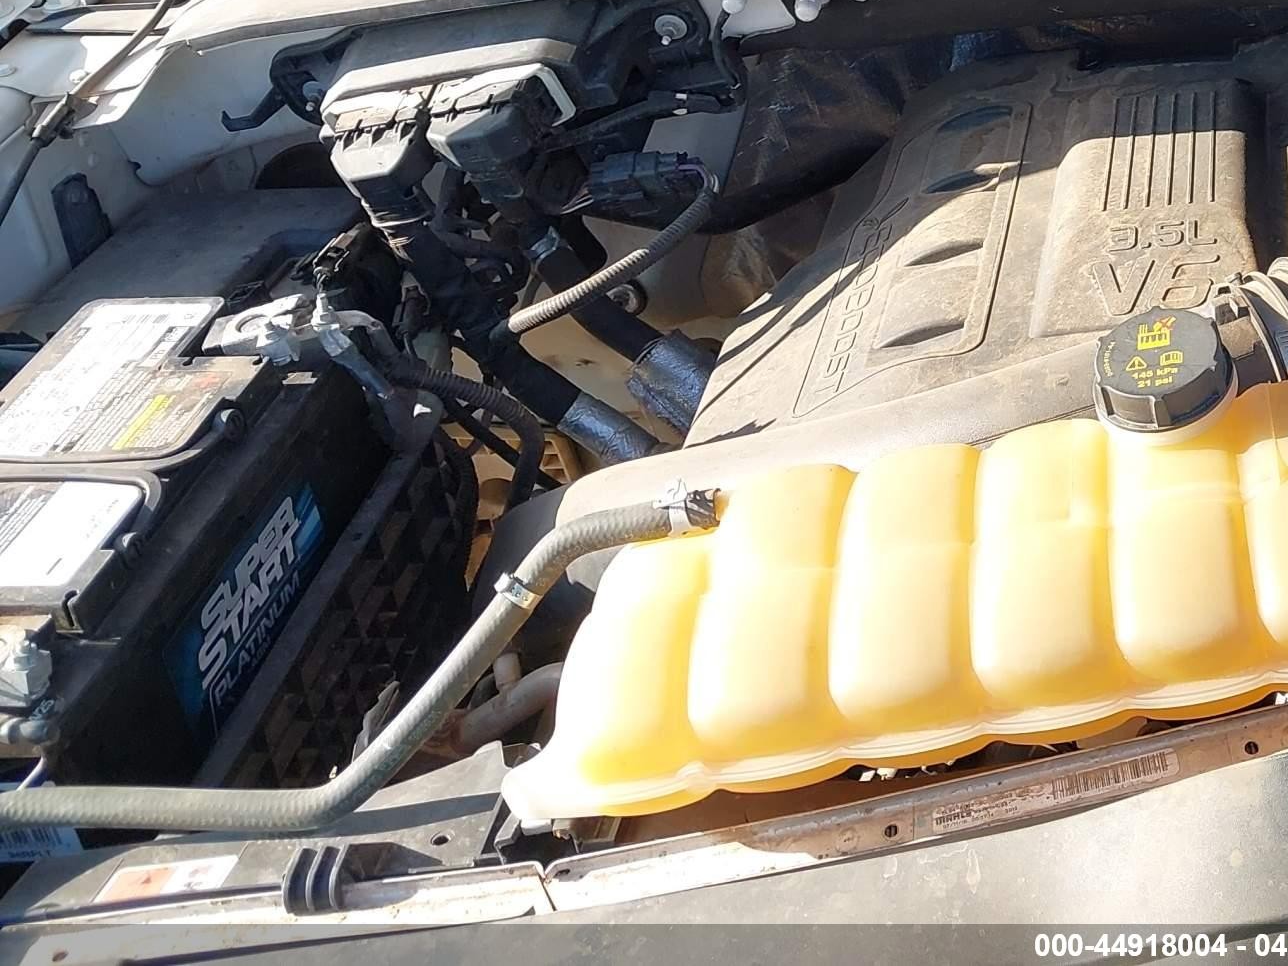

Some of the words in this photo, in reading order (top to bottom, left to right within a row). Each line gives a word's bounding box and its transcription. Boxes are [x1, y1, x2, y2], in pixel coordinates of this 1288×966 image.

[1093, 254, 1220, 316] V6
[1104, 220, 1217, 253] 3.5L
[1138, 379, 1151, 387] 21
[1155, 376, 1173, 386] psi
[198, 518, 302, 690] START
[201, 496, 295, 630] SUPER
[214, 570, 301, 707] PLATINUM
